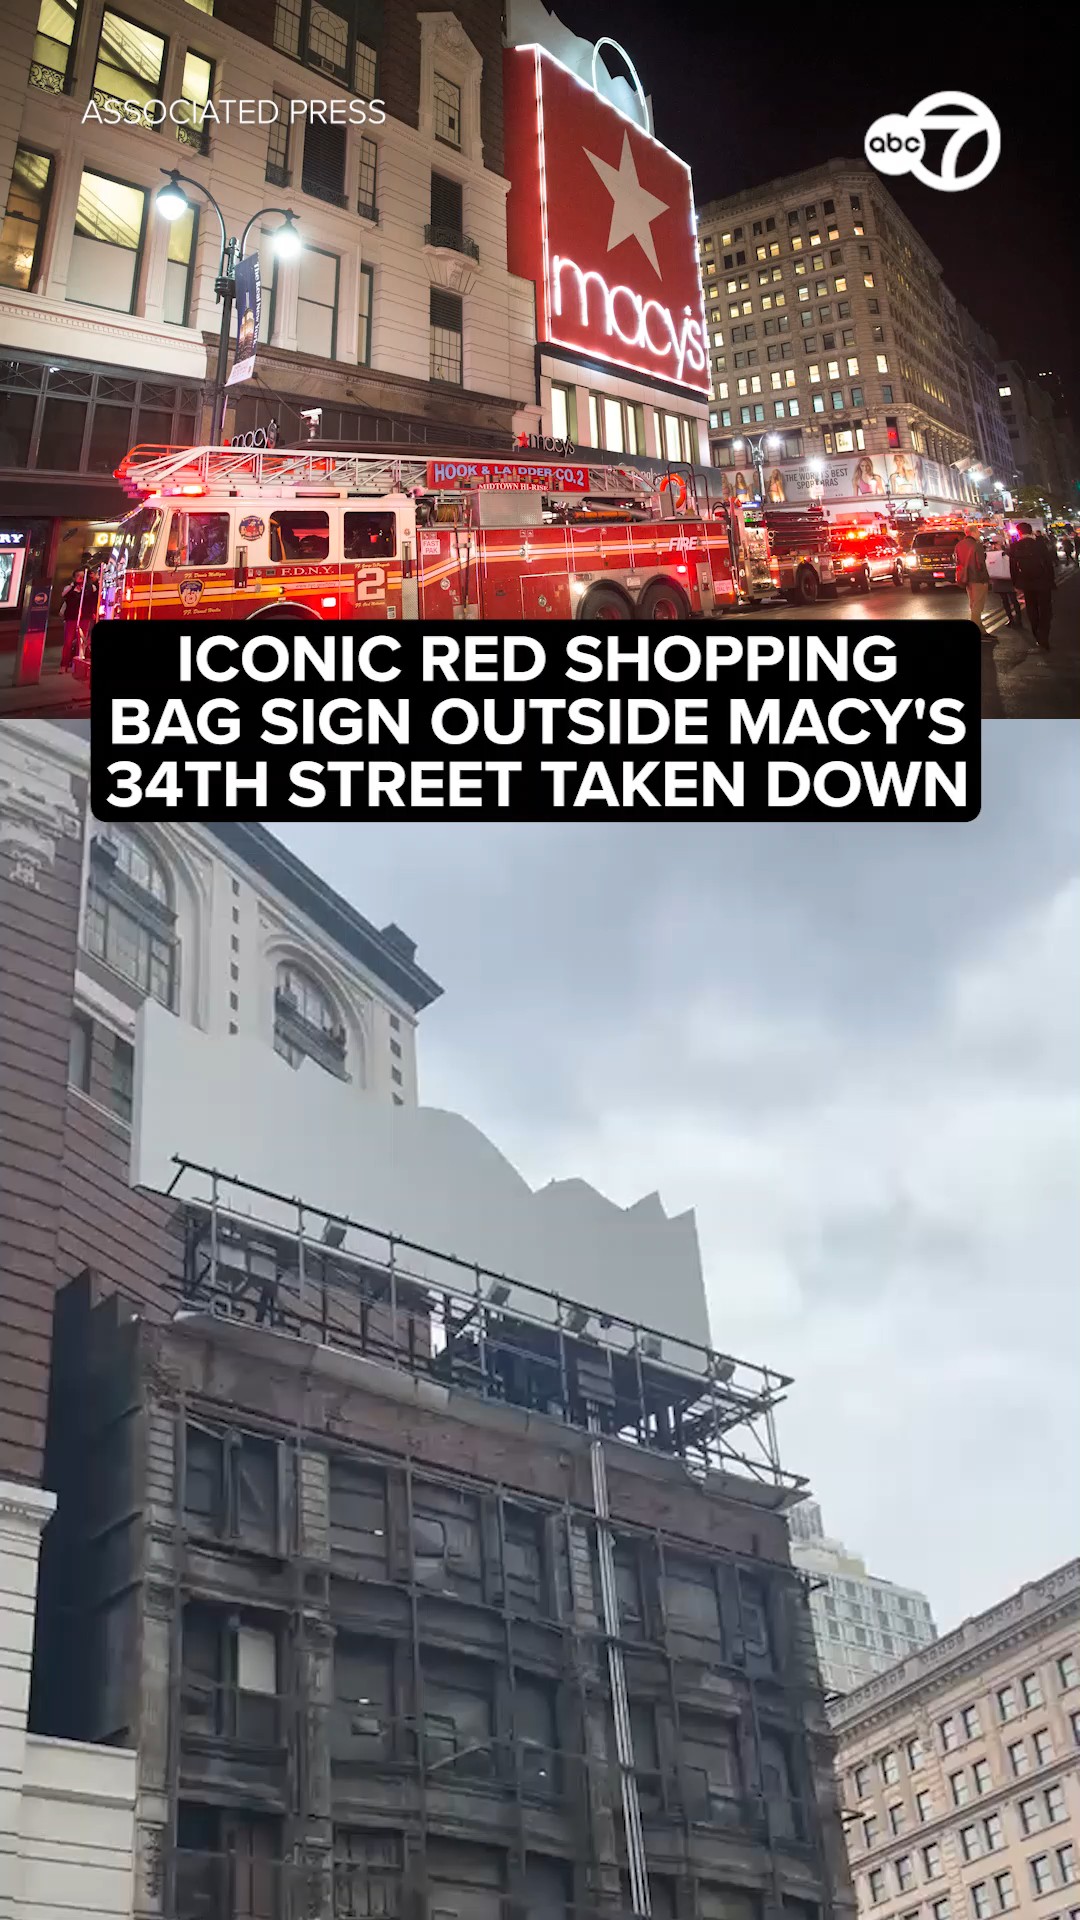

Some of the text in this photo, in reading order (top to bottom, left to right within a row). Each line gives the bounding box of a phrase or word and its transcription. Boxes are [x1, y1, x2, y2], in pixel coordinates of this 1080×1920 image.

[553, 254, 705, 380] macy's
[529, 433, 575, 458] macy's
[434, 463, 477, 483] HOOK
[481, 466, 491, 475] &
[785, 473, 798, 482] THE
[830, 468, 849, 478] BEST
[478, 482, 519, 490] MIDTOWN
[668, 536, 698, 552] FIRE
[281, 565, 335, 576] F.D.N.Y.
[357, 567, 386, 601] 2
